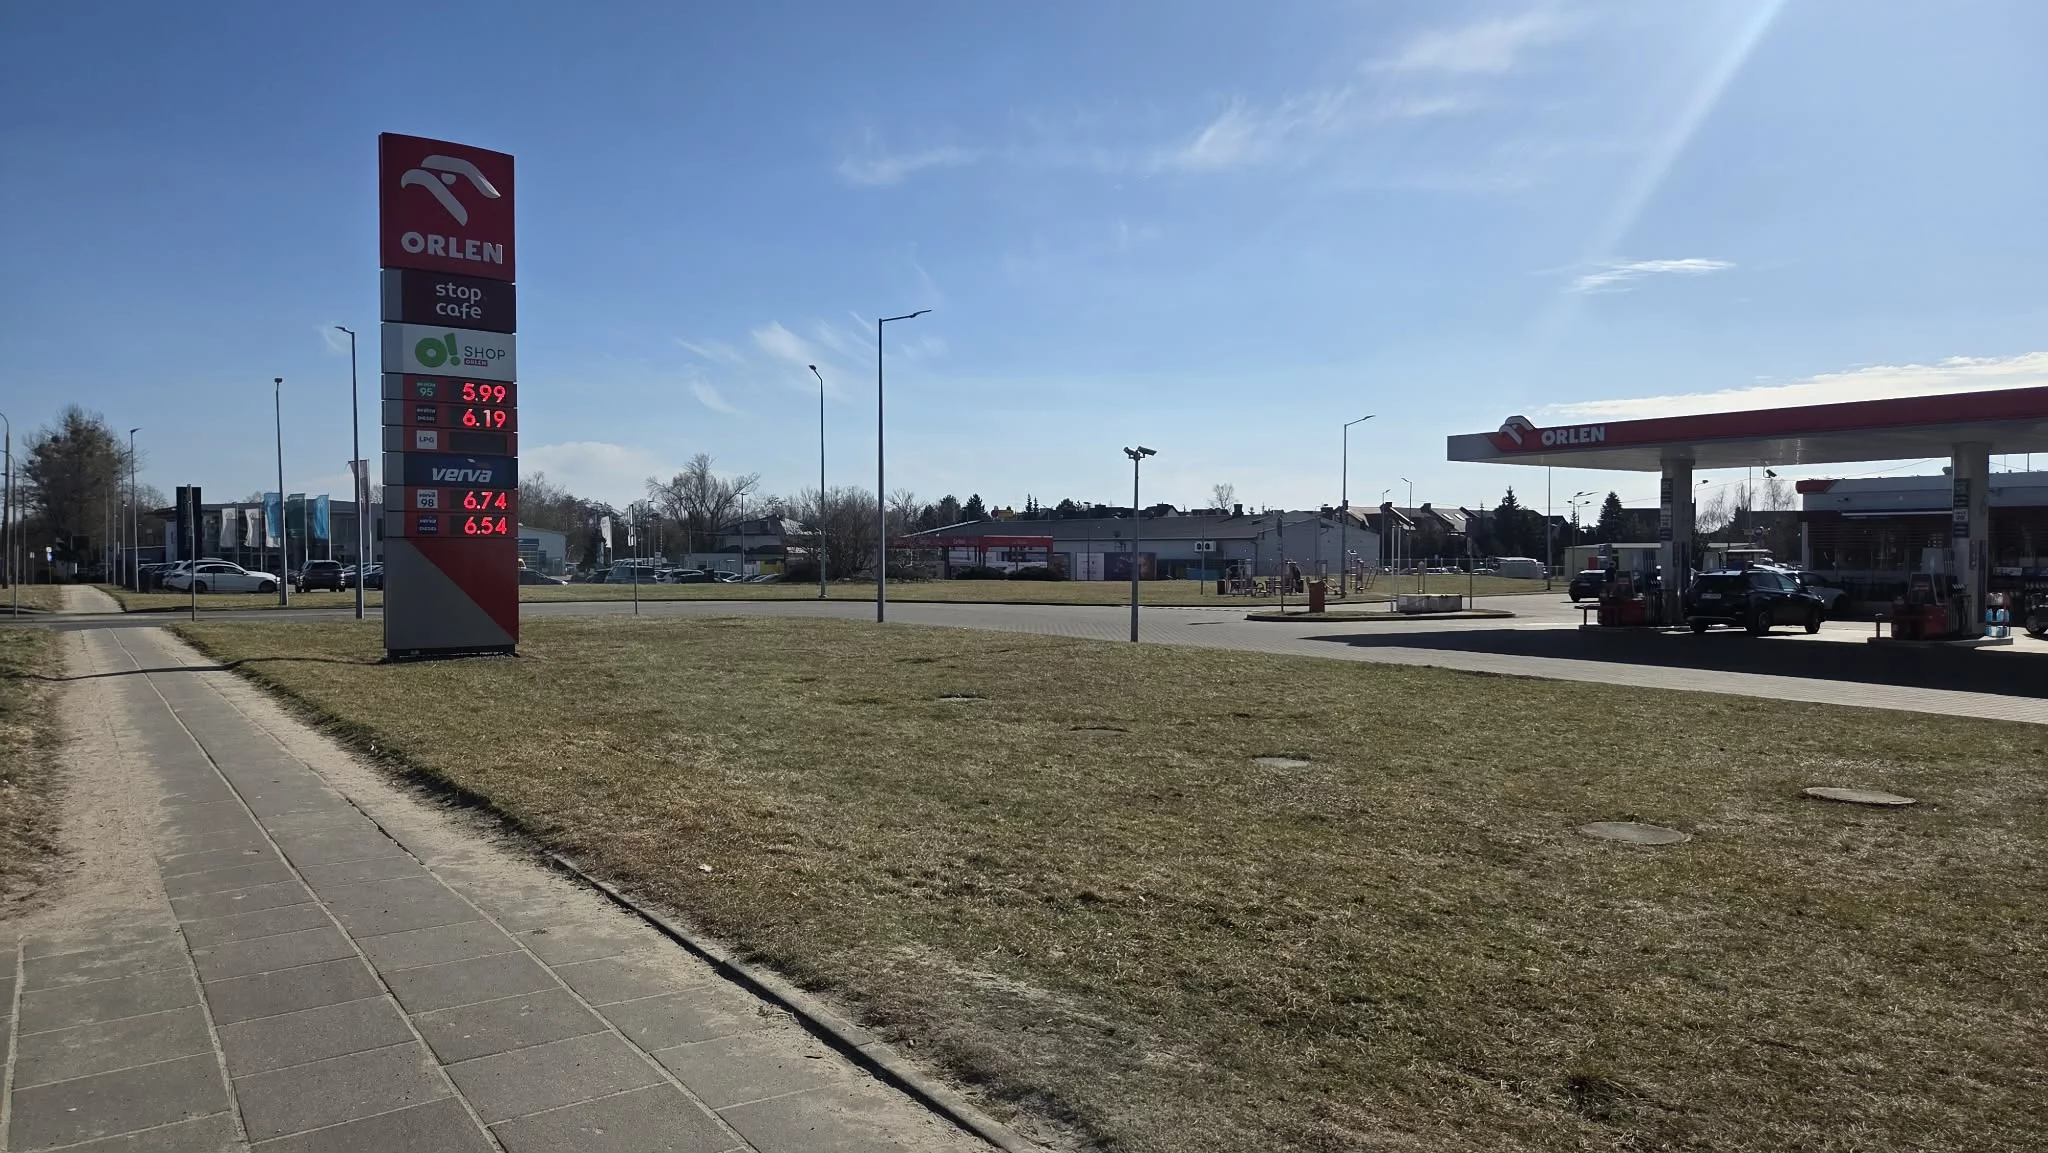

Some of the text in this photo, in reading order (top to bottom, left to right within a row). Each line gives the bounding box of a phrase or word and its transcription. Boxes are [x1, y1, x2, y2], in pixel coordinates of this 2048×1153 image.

[402, 232, 503, 264] ORLEN
[436, 282, 482, 304] stop
[436, 302, 482, 319] cafe
[464, 346, 506, 360] SHOP
[420, 387, 434, 397] 95
[462, 382, 506, 403] 5.99
[462, 408, 506, 428] 6.19
[419, 436, 435, 444] LPG
[1541, 426, 1605, 446] ORLEN
[432, 467, 493, 483] verva
[421, 498, 434, 508] 98
[464, 491, 506, 510] 6.74
[464, 516, 507, 535] 6.54
